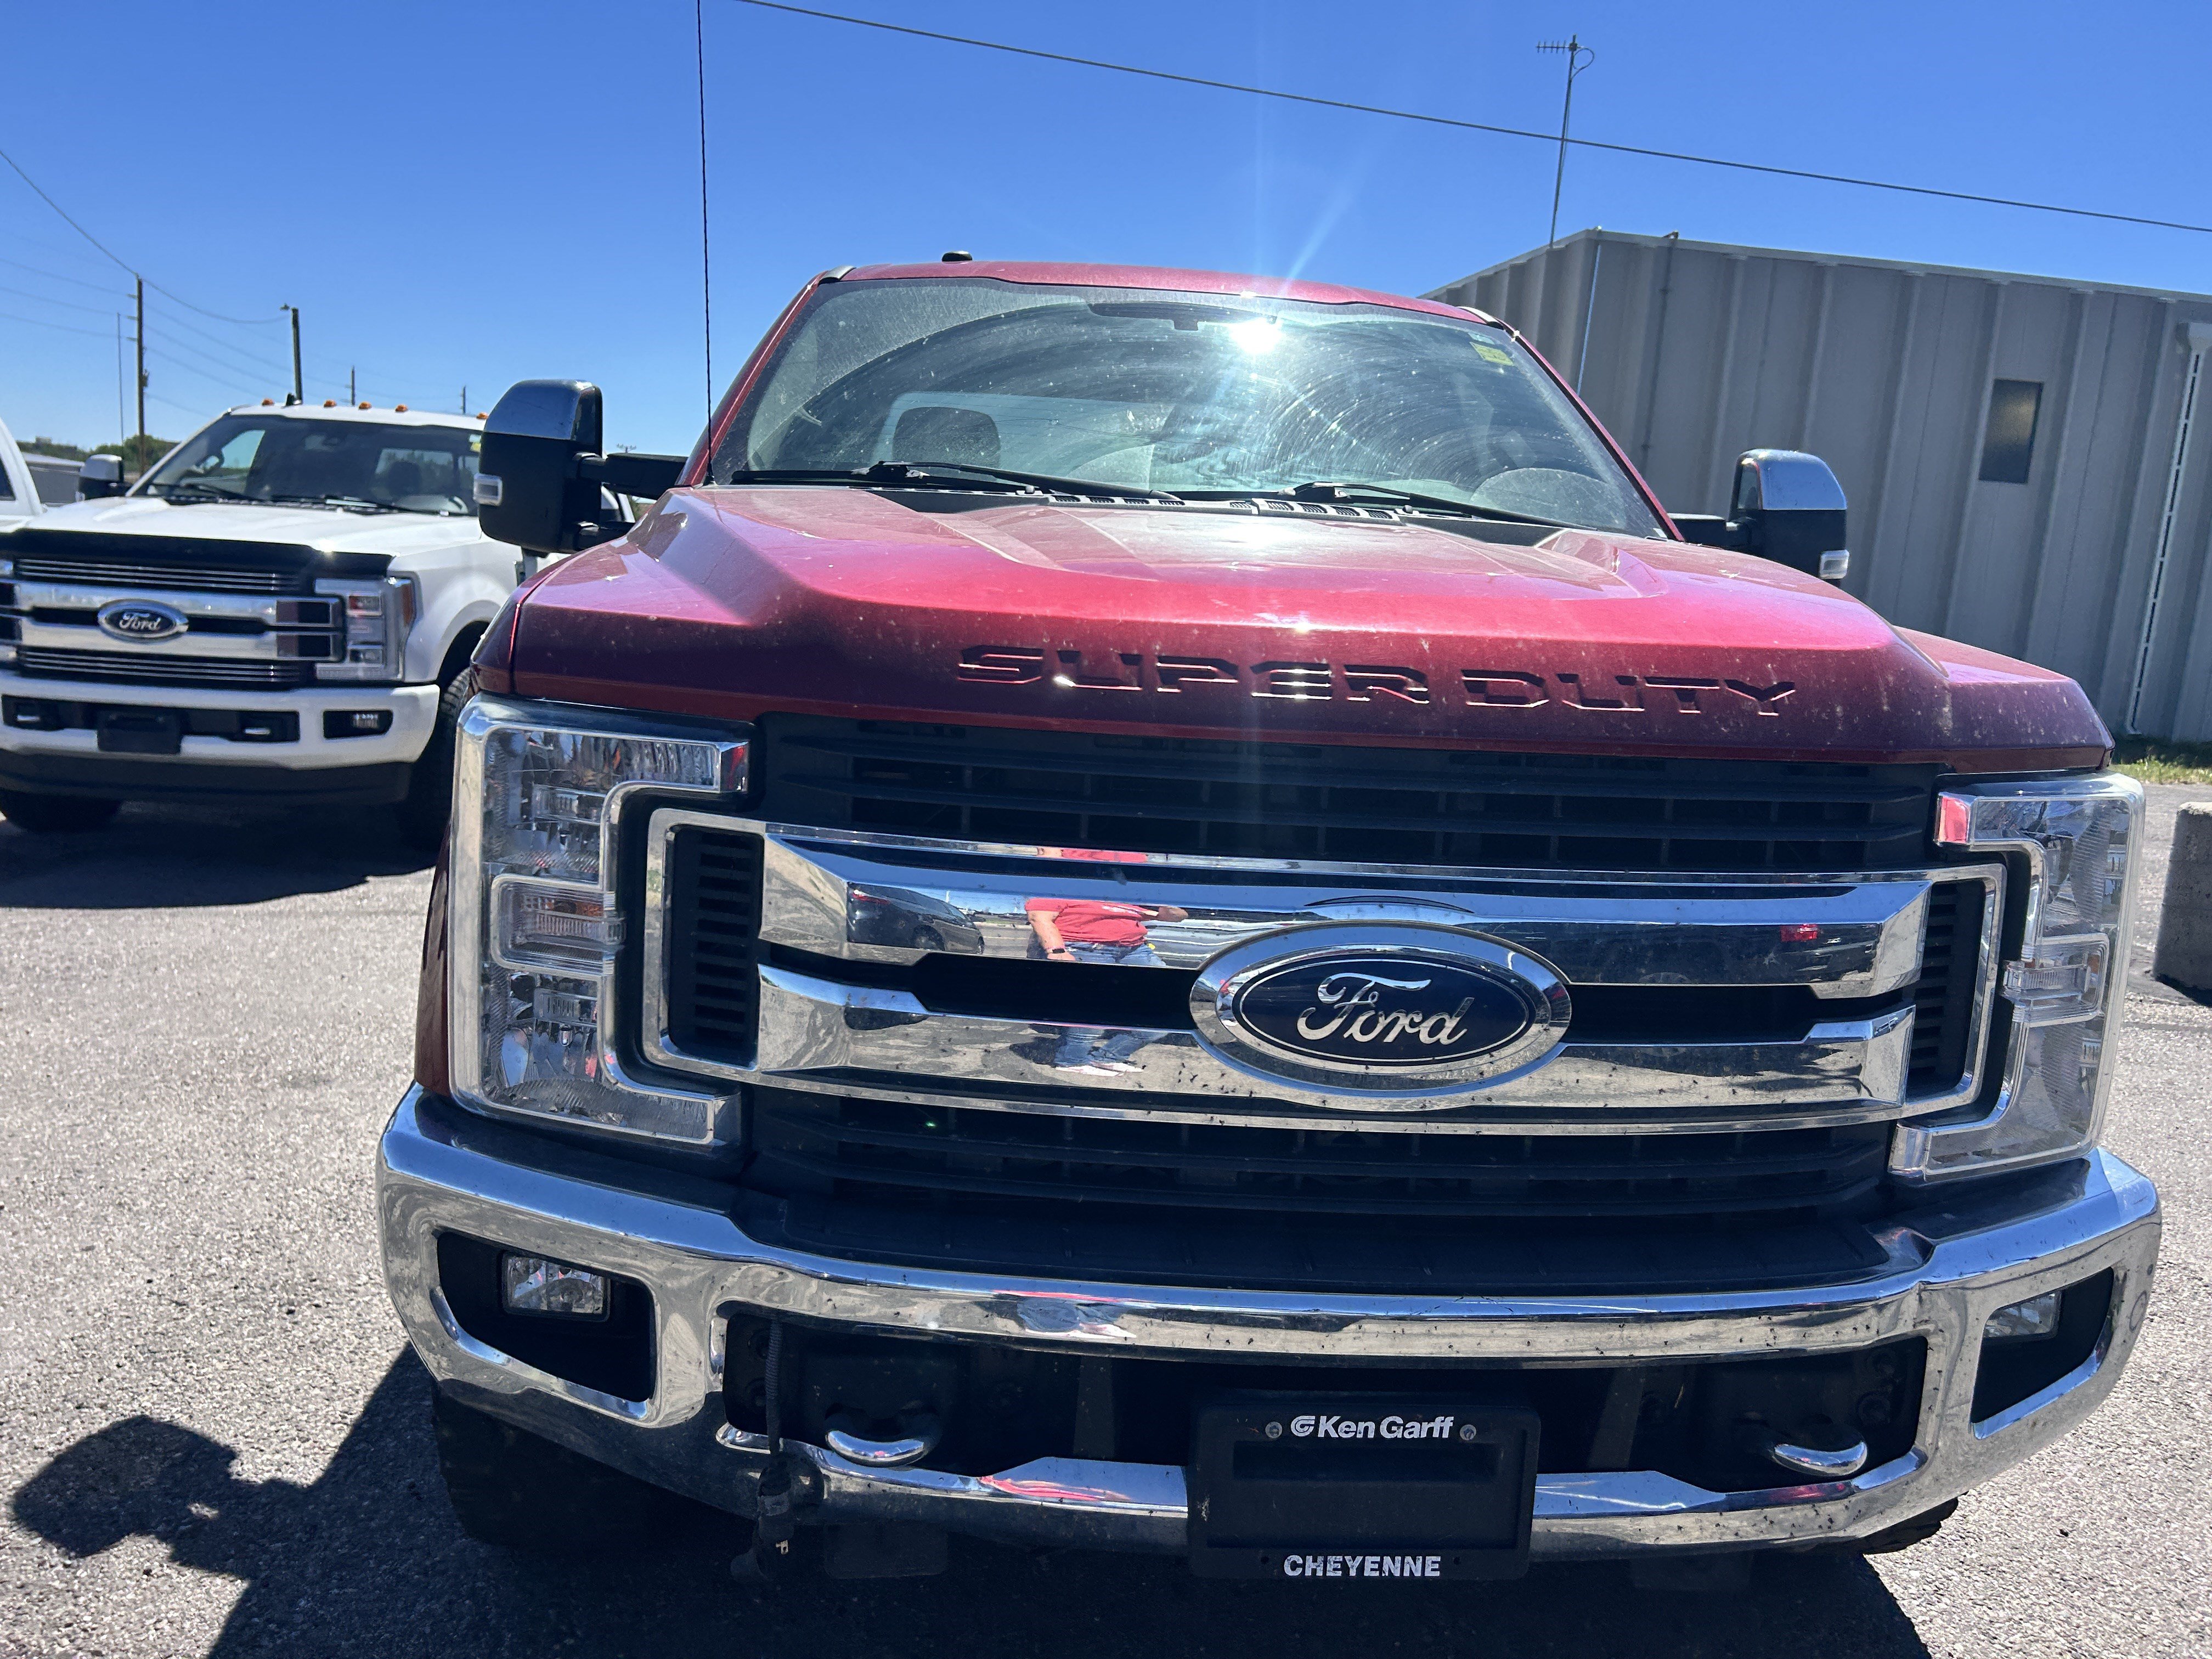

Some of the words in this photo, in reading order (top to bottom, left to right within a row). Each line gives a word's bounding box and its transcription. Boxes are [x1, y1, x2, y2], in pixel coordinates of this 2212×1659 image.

[119, 611, 161, 630] Ford
[957, 645, 1430, 704] SUPER
[1460, 668, 1796, 716] DUTY
[1296, 972, 1475, 1045] Ford
[1318, 1415, 1375, 1438] Ken
[1379, 1415, 1454, 1438] Garff
[1284, 1555, 1441, 1577] CHEYENNE
